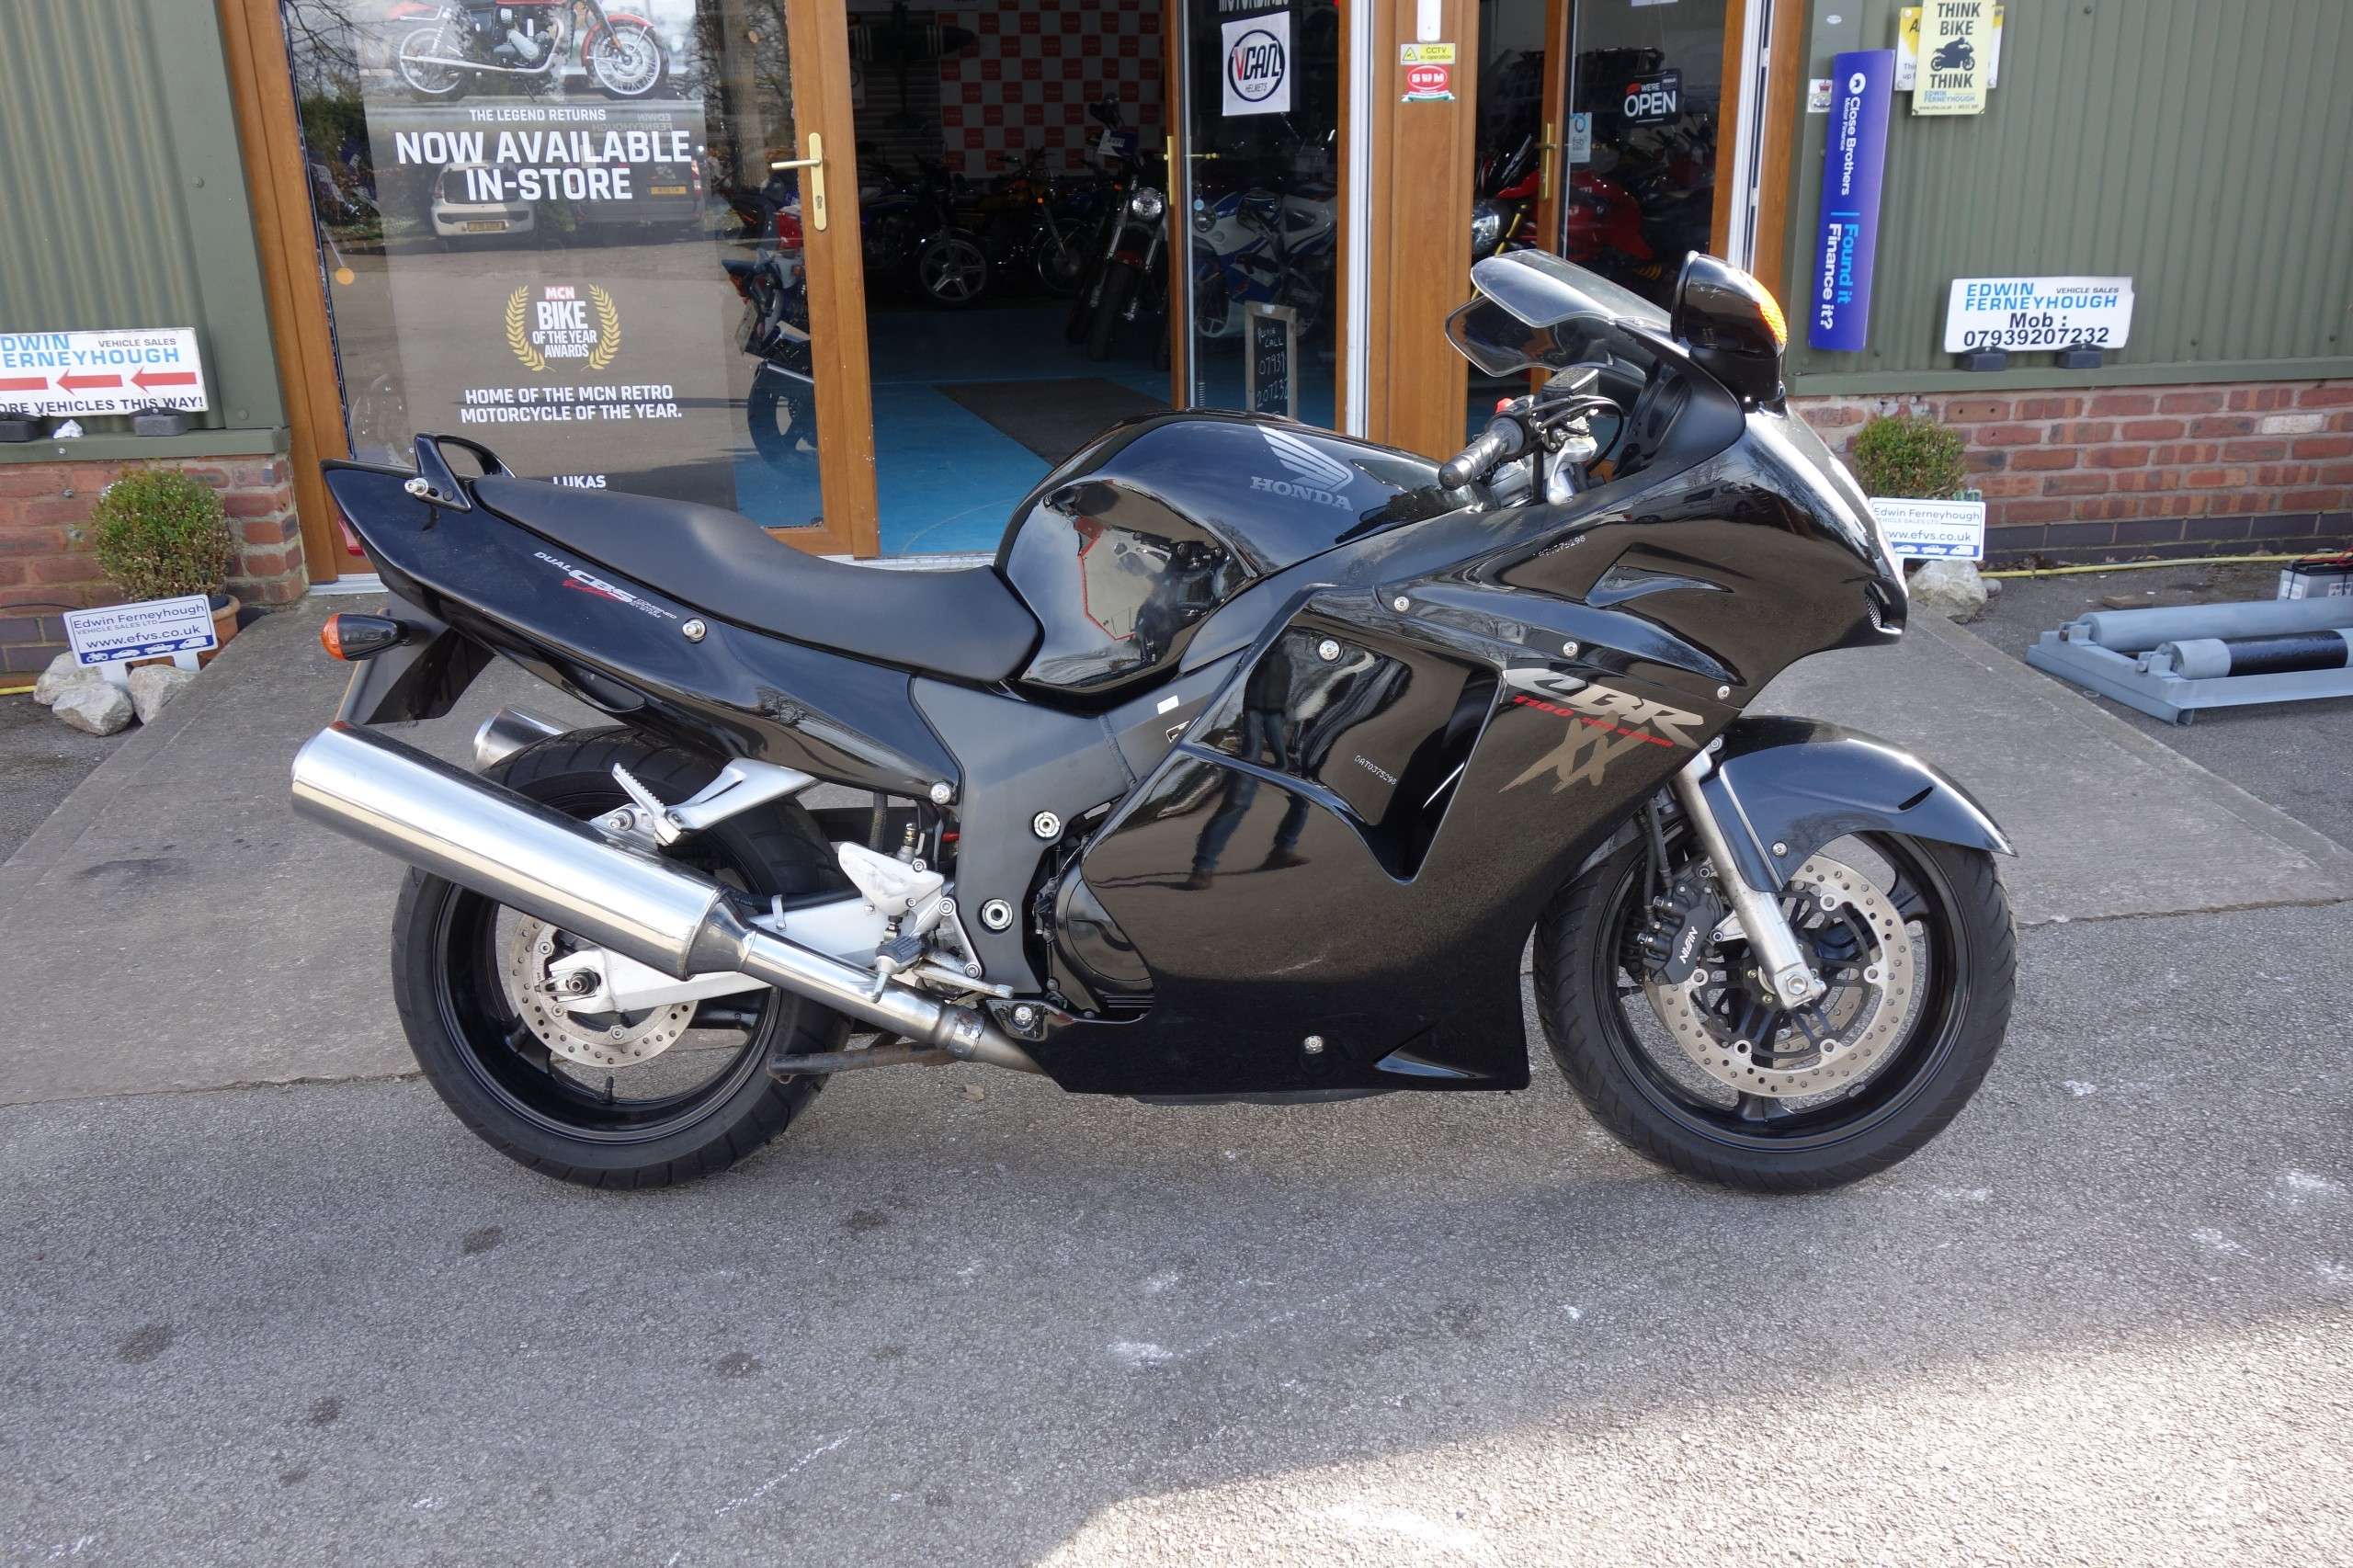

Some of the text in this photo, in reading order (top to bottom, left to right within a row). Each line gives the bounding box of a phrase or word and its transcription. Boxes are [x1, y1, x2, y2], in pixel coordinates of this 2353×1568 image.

[1938, 3, 1982, 17] THINK
[1940, 20, 1974, 36] BIKE
[1411, 73, 1444, 83] SWM
[1929, 74, 1974, 88] THINK
[1624, 90, 1677, 117] OPEN
[470, 108, 607, 121] THE LEGEND RETURNS
[395, 130, 691, 165] NOW AVAILABLE
[1841, 97, 1861, 196] Close Brothers
[465, 167, 633, 200] IN-STORE
[1837, 223, 1859, 304] Found it
[1820, 223, 1842, 330] Finance it?
[544, 286, 575, 300] MCN
[1967, 282, 2034, 297] EDWIN
[1965, 295, 2119, 311] FERNEYHOUGH
[536, 301, 589, 330] BIKE
[0, 334, 71, 351] DWIN
[98, 337, 176, 347] VEHICLE SALES
[532, 330, 597, 345] OF THE YEAR
[1963, 326, 2109, 347] 07939207232
[2, 347, 180, 368] ERNEYHOUGH
[544, 344, 589, 358] AWARDS
[465, 384, 673, 404] HOME OF THE MCN RETRO
[0, 396, 204, 414] ORE VEHICLES THIS WAY!
[460, 403, 682, 424] MOTORCYCLE OF THE YEAR.
[1249, 476, 1354, 512] HONDA
[1874, 506, 1980, 522] Edwin Ferneyhough
[533, 551, 572, 572] DUAL
[568, 569, 638, 603] CBS
[74, 604, 205, 630] Edwin Ferneyhough
[85, 624, 200, 649] www.efvs.co.uk
[1505, 668, 1704, 749] CBR
[1498, 710, 1651, 794] XX
